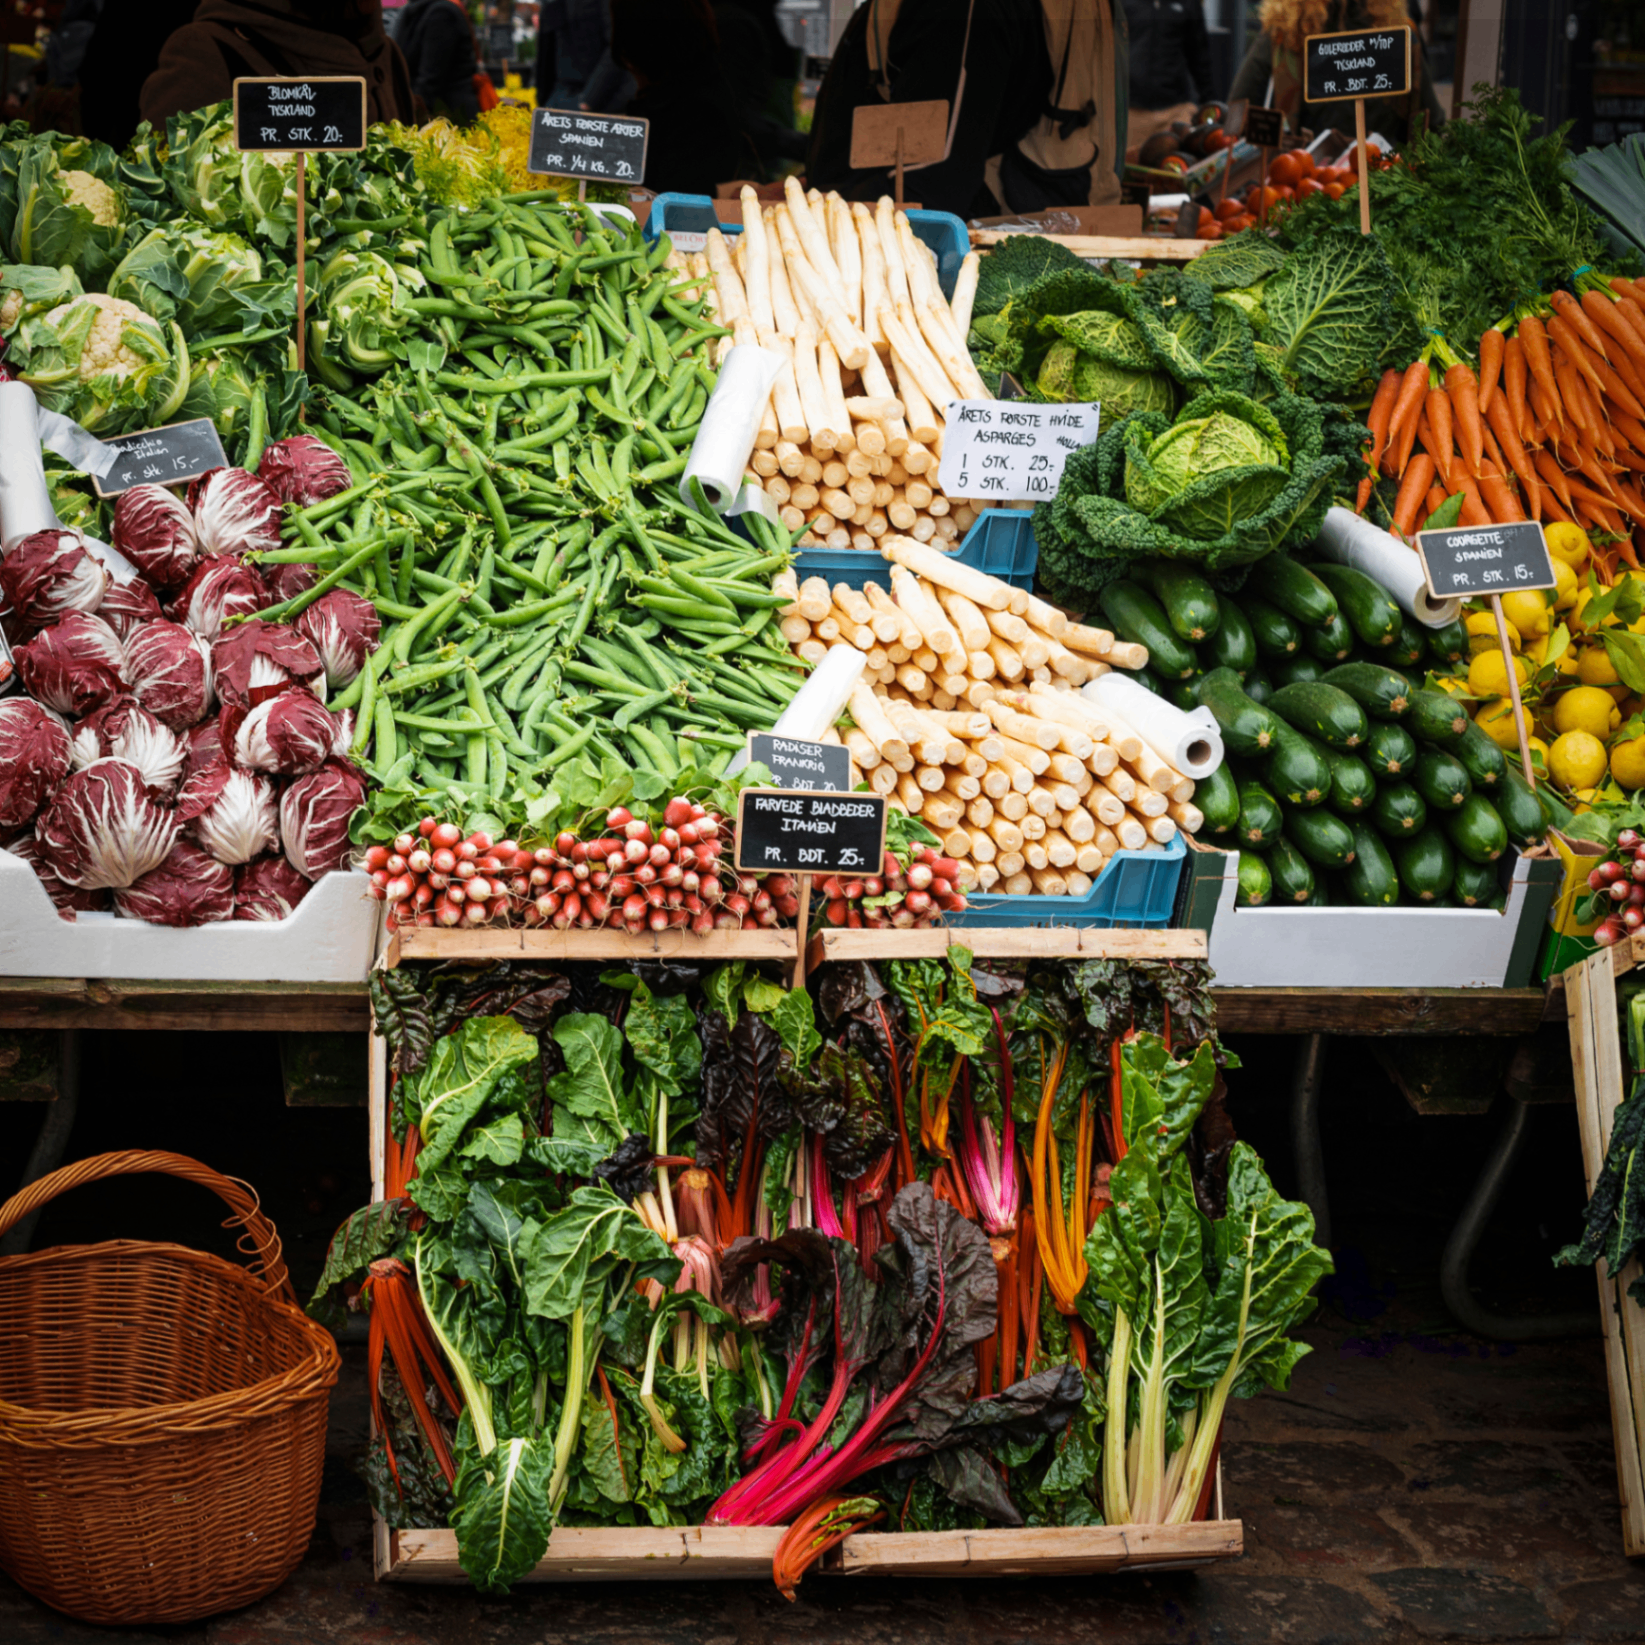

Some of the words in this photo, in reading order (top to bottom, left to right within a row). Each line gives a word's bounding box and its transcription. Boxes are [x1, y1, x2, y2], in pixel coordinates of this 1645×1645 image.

[1334, 56, 1376, 71] TYSKLAND
[267, 83, 317, 101] BLOMKÅL
[268, 103, 316, 117] TYSKLAND
[541, 111, 572, 129] ÅRETS
[958, 405, 992, 423] ÅRETS
[1000, 412, 1041, 427] FØRSTE
[973, 429, 1036, 447] ASPARGES
[957, 472, 969, 488] 5
[1446, 531, 1505, 548] COURGETTE
[755, 797, 804, 815] FARVEDE
